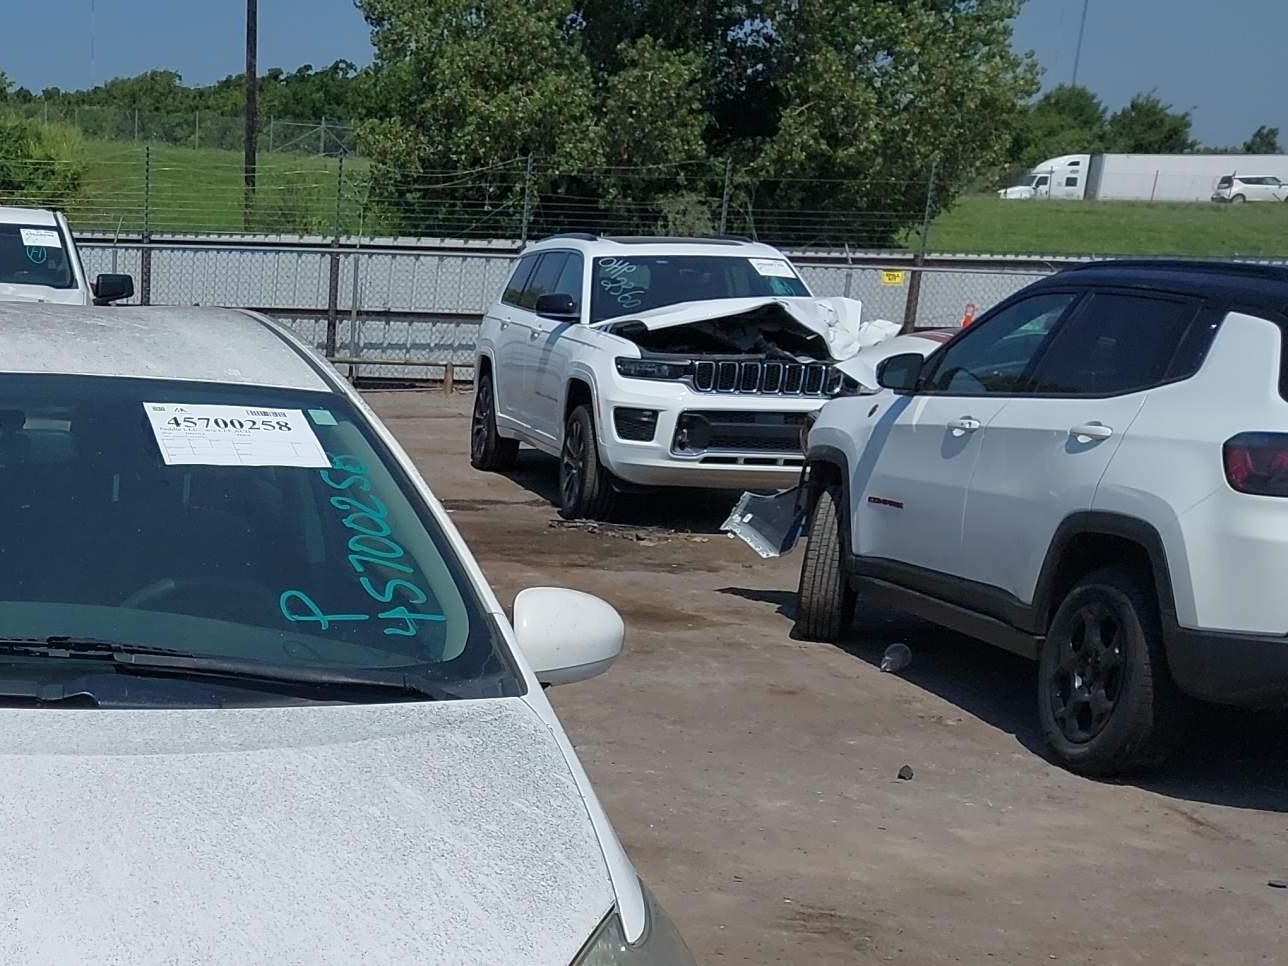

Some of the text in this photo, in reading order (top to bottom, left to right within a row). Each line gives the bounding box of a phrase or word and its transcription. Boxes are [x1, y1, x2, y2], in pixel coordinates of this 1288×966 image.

[598, 257, 637, 279] OHP
[167, 416, 293, 432] 45700258
[320, 453, 447, 636] 45700258
[279, 590, 370, 630] P
